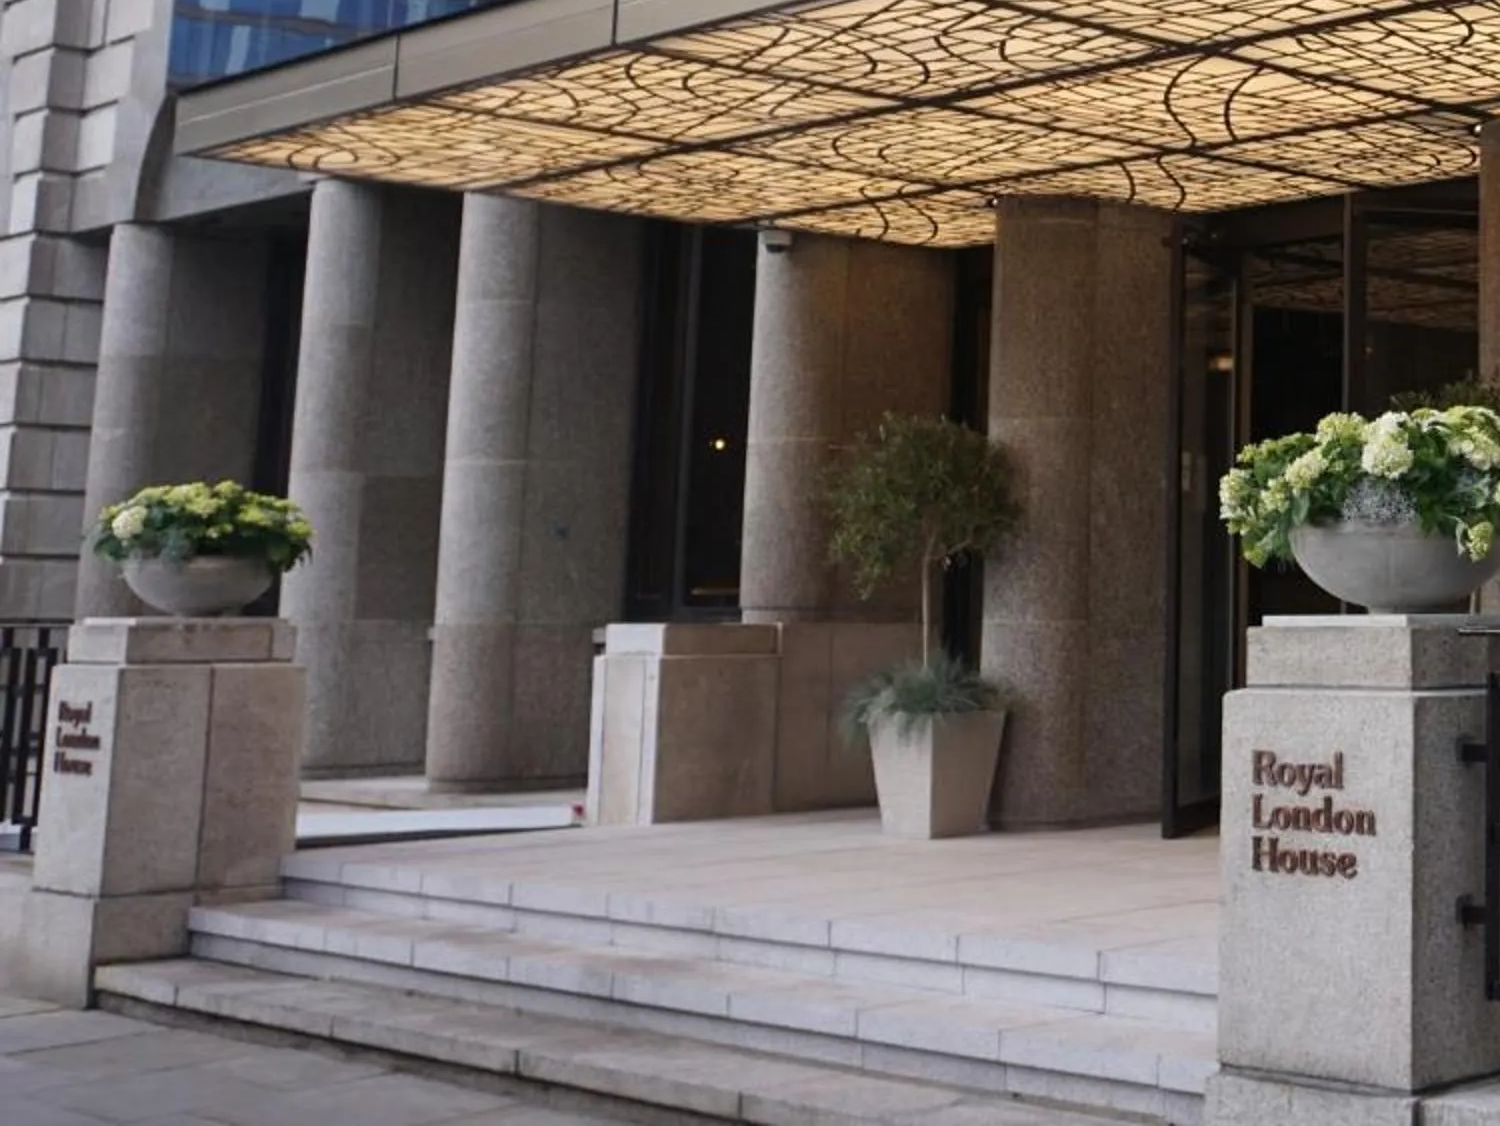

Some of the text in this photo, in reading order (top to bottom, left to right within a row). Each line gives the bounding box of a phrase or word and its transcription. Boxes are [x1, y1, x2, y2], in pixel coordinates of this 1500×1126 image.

[1251, 748, 1345, 797] Royal
[1251, 793, 1378, 837] London
[1251, 835, 1359, 881] House
